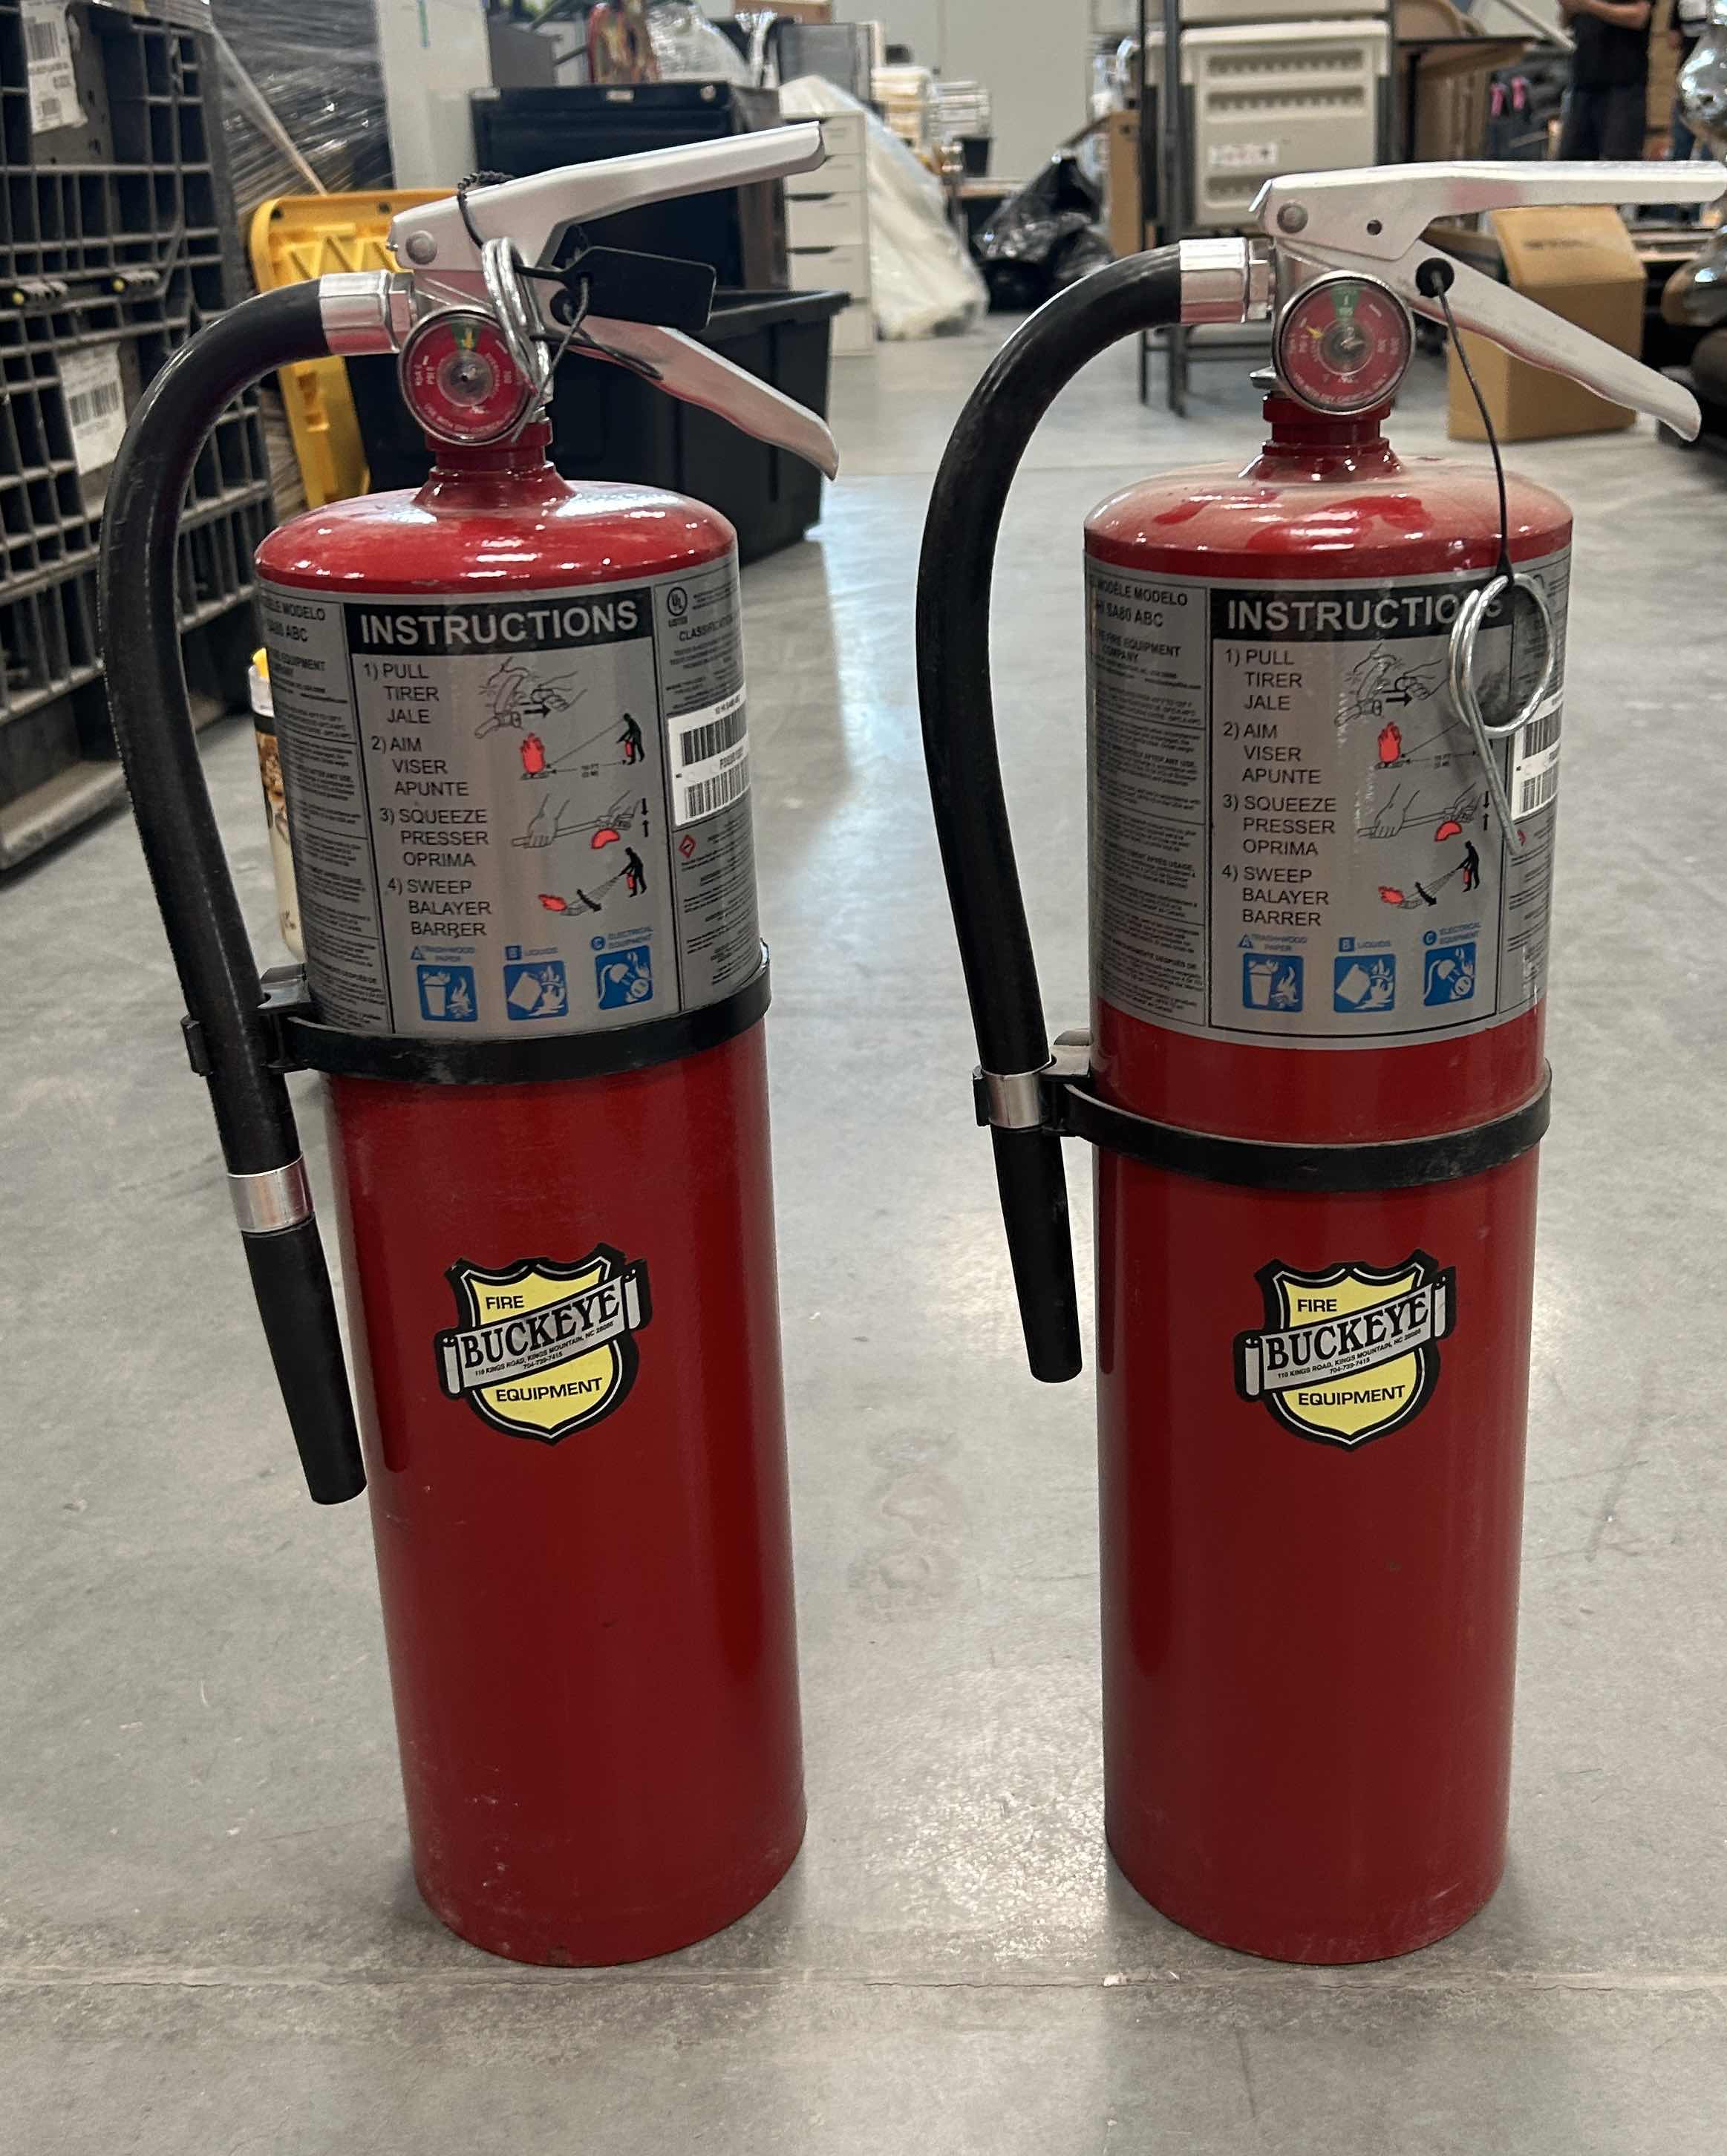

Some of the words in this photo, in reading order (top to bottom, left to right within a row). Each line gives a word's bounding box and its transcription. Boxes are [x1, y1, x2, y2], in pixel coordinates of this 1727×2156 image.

[1134, 587, 1188, 607] MODELO
[1134, 609, 1163, 627] ABC
[1228, 594, 1502, 631] INSTRUCTIOS
[360, 600, 639, 645] INSTRUCTIONS
[1225, 649, 1241, 667] 1)
[1246, 648, 1295, 666] PULL
[364, 663, 379, 682] 1)
[383, 662, 429, 680] PULL
[1246, 671, 1303, 689] TIRER
[383, 685, 440, 702] TIRER
[1244, 695, 1291, 711] JALE
[386, 708, 431, 725] JALE
[1223, 721, 1240, 741] 2)
[1244, 722, 1277, 739] AIM
[372, 736, 387, 755] 2)
[389, 736, 422, 752] AIM
[1244, 745, 1302, 762] VISER
[391, 758, 448, 775] VISER
[1241, 768, 1322, 785] APUNTE
[394, 781, 470, 797] APUNTE
[1222, 794, 1238, 812] 3)
[1244, 795, 1336, 813] SQUEEZE
[380, 808, 395, 826] 3)
[399, 808, 488, 825] SQUEEZE
[1242, 817, 1336, 834] PRESSER
[401, 830, 490, 846] PRESSER
[1242, 838, 1319, 856] OPRIMA
[403, 851, 477, 867] OPRIMA
[1221, 863, 1238, 883] 4)
[1244, 866, 1313, 883] SWEEP
[387, 877, 402, 897] 4)
[407, 878, 472, 895] SWEEP
[1242, 886, 1330, 906] BALAYER
[408, 899, 493, 915] BALAYER
[1242, 908, 1322, 927] BARRER
[411, 921, 488, 937] BARRER
[485, 1295, 525, 1310] FIRE
[1297, 1298, 1337, 1313] FIRE
[460, 1284, 620, 1369] BUCKEYE
[1266, 1291, 1429, 1371] BUCKEYE
[495, 1377, 603, 1402] EQUIPMENT
[1299, 1385, 1406, 1405] EQUIPMENT
